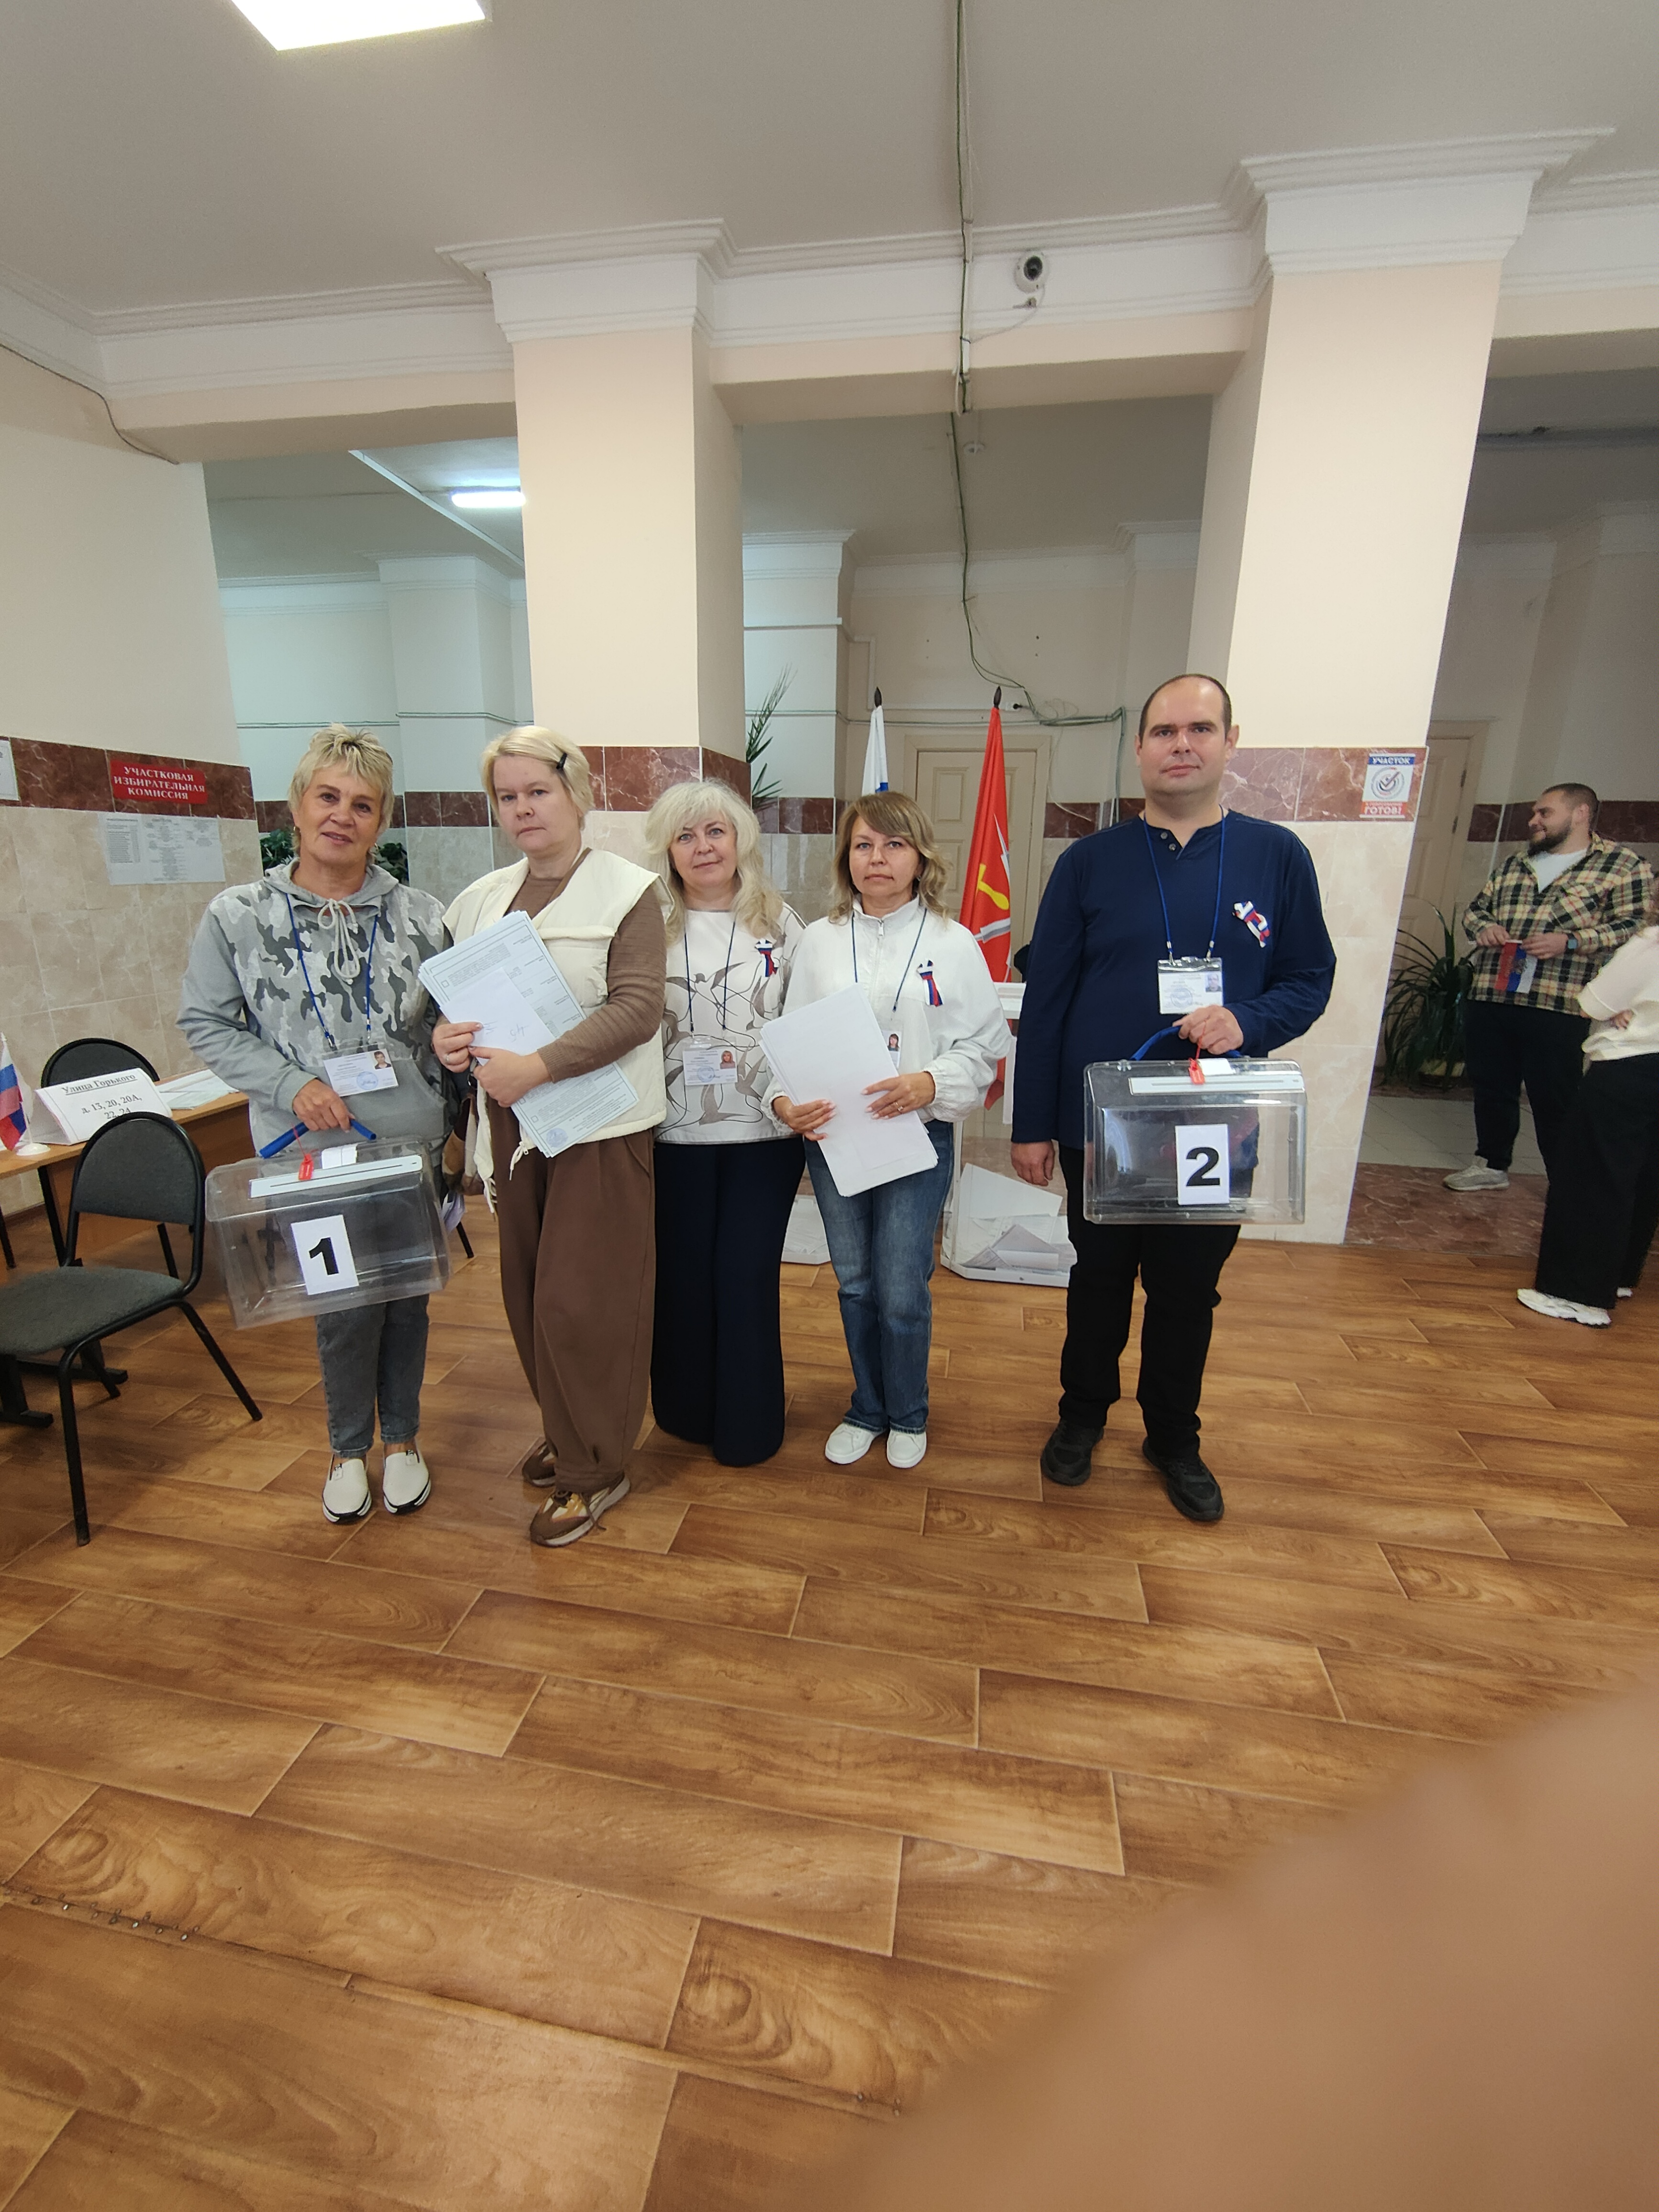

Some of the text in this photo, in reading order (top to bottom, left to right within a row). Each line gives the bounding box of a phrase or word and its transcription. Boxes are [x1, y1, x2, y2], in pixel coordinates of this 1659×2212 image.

[124, 766, 194, 782] УЧАСТКОВАЯ
[114, 776, 205, 792] ИЗБИРАТЕЛЬНАЯ
[128, 787, 188, 799] КОМИССИЯ
[1364, 806, 1402, 815] ГОТОВ!
[61, 1074, 136, 1094] Улица Горького
[91, 1102, 106, 1111] 13,
[105, 1099, 121, 1108] 20,
[121, 1094, 143, 1104] 20А,
[1185, 1147, 1220, 1187] 2
[309, 1237, 339, 1276] 1
